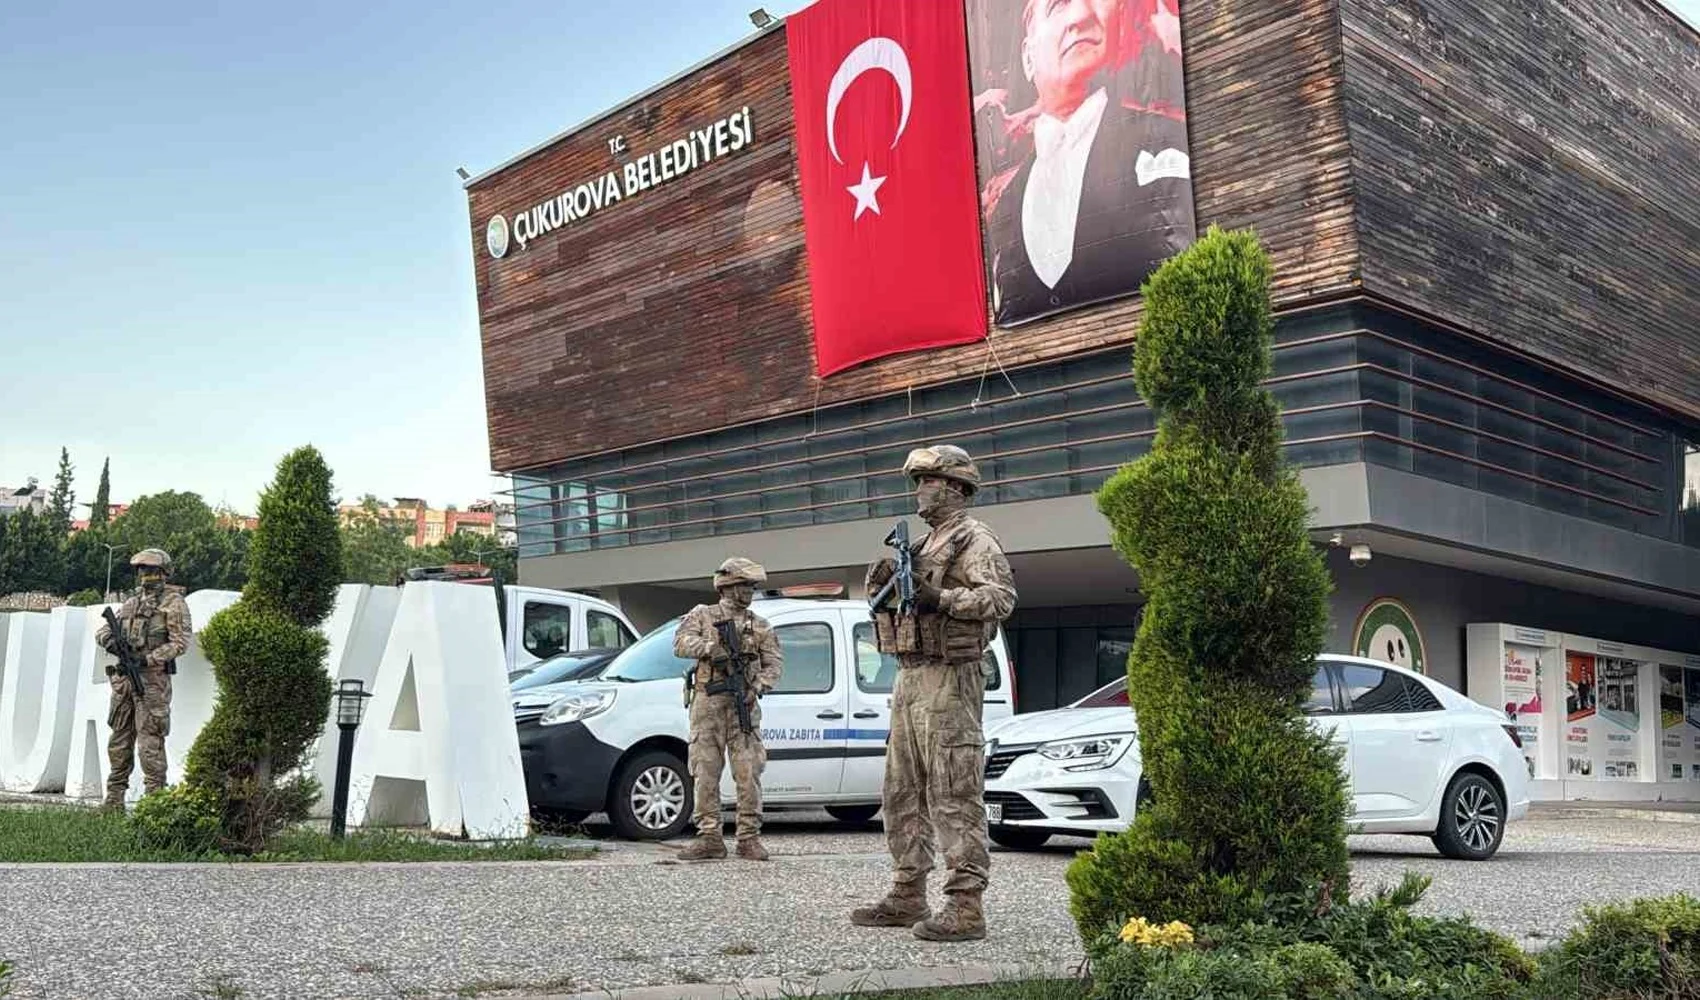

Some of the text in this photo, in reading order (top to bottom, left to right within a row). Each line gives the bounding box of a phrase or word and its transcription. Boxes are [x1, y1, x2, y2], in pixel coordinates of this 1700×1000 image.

[513, 106, 752, 250] ÇUKUROVA BELEDİYESİ
[760, 728, 820, 740] ROVA ZABITA
